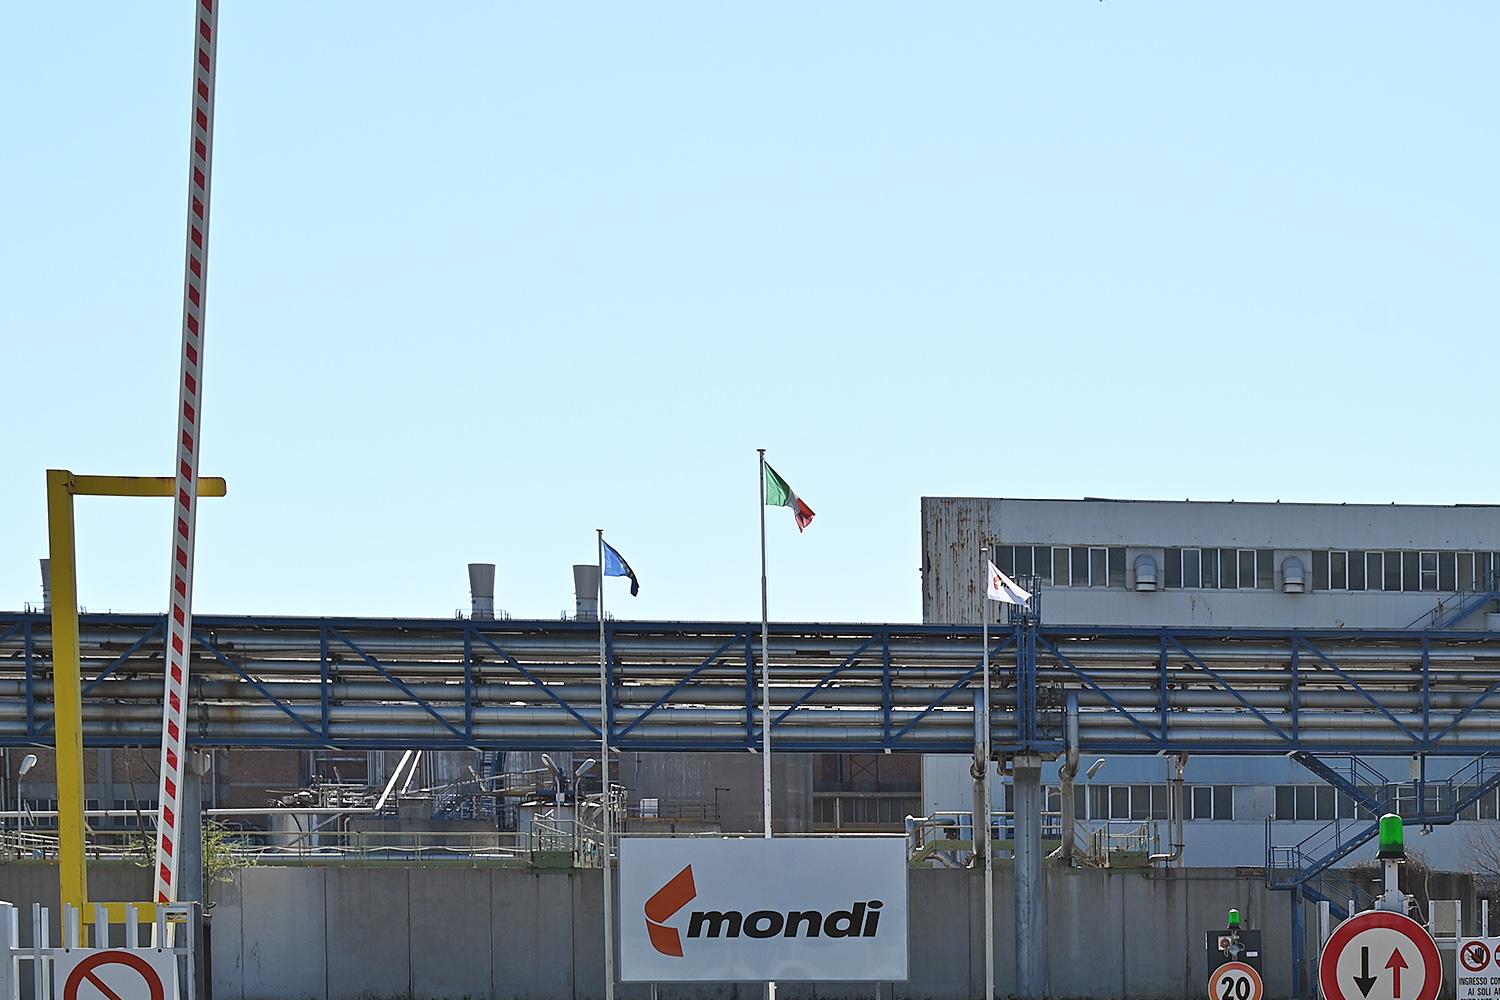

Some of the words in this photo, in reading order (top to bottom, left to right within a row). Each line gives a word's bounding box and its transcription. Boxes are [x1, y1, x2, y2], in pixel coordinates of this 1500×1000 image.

[686, 899, 884, 939] mondi
[1222, 977, 1250, 1000] 20
[1459, 977, 1487, 985] INGRESSO
